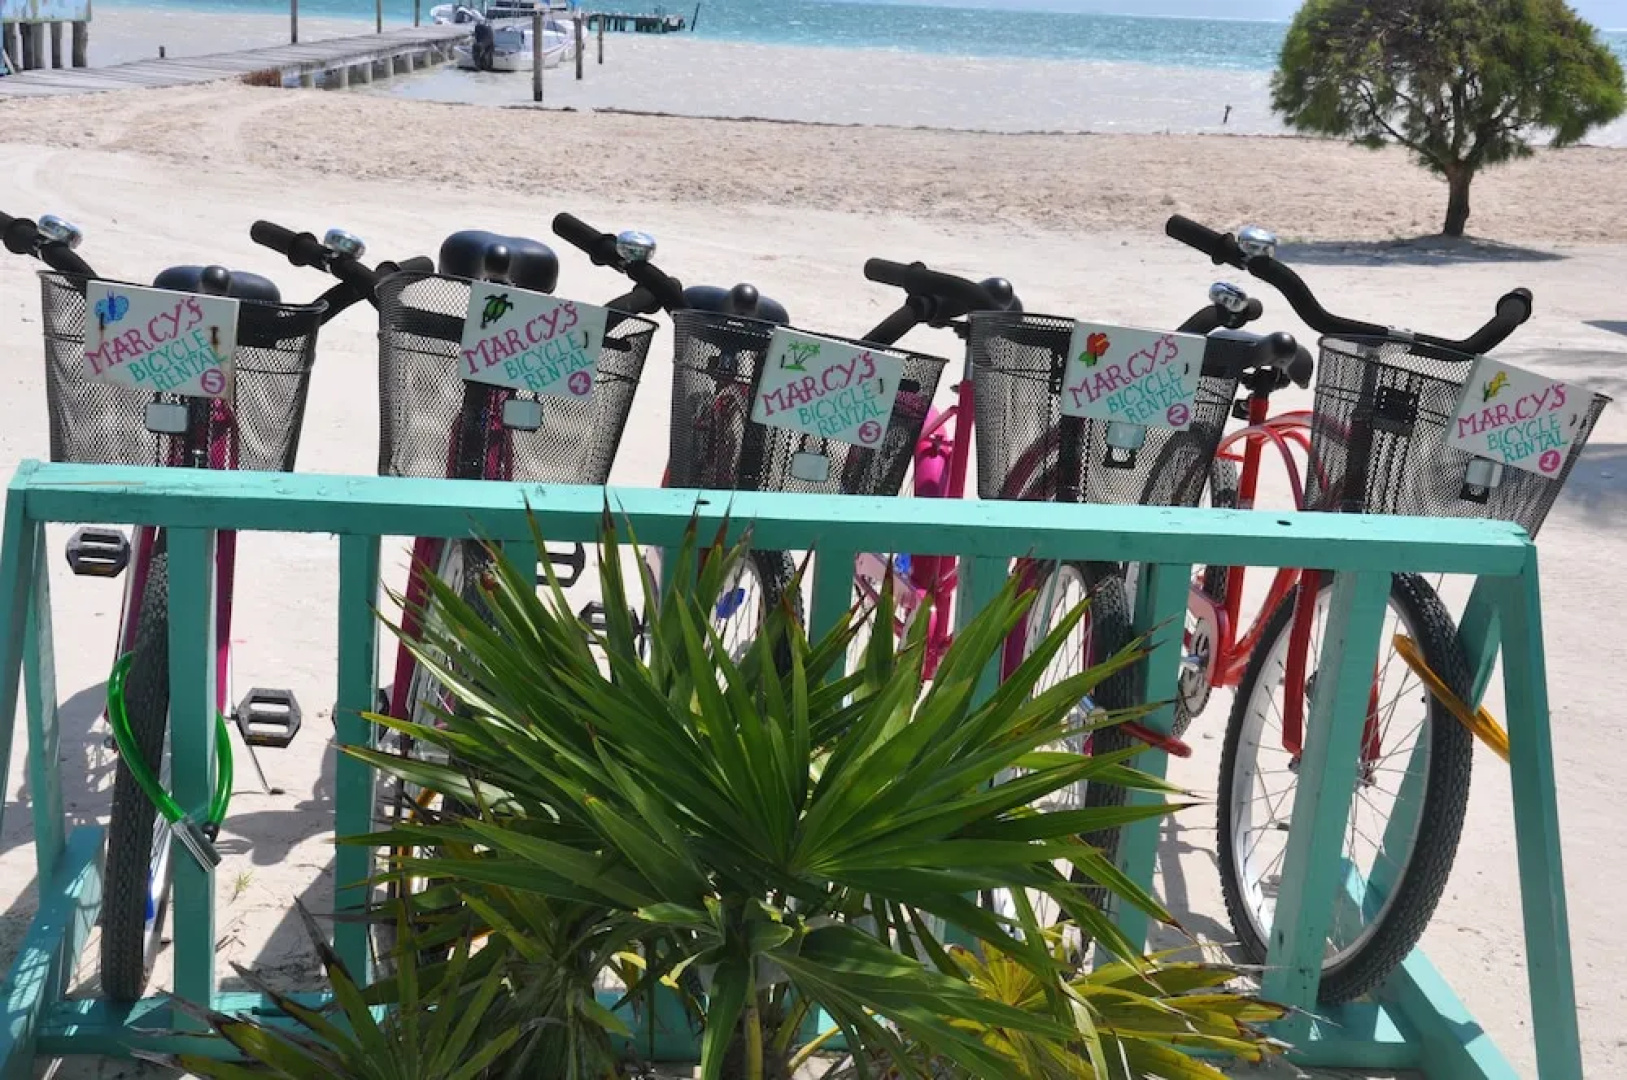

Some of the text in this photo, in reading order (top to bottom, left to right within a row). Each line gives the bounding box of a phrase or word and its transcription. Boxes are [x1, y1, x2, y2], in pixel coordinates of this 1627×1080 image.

[85, 296, 203, 376] MARCY'S
[127, 329, 209, 382] BICYCLE
[462, 301, 578, 374] MARCY'S
[504, 332, 582, 380] BICYCLE
[151, 348, 227, 391] RENTAL
[524, 350, 594, 390] RENTAL
[763, 351, 876, 416] MARCY'S
[1069, 334, 1178, 408] MARCY'S
[1106, 365, 1182, 414] BICYCLE
[799, 382, 875, 425] BICYCLE
[818, 401, 888, 437] RENTAL
[1124, 380, 1193, 424] RENTAL
[1458, 382, 1565, 439] MARCY'S
[1487, 413, 1560, 450] BICYCLE
[1502, 431, 1568, 463] RENTAL
